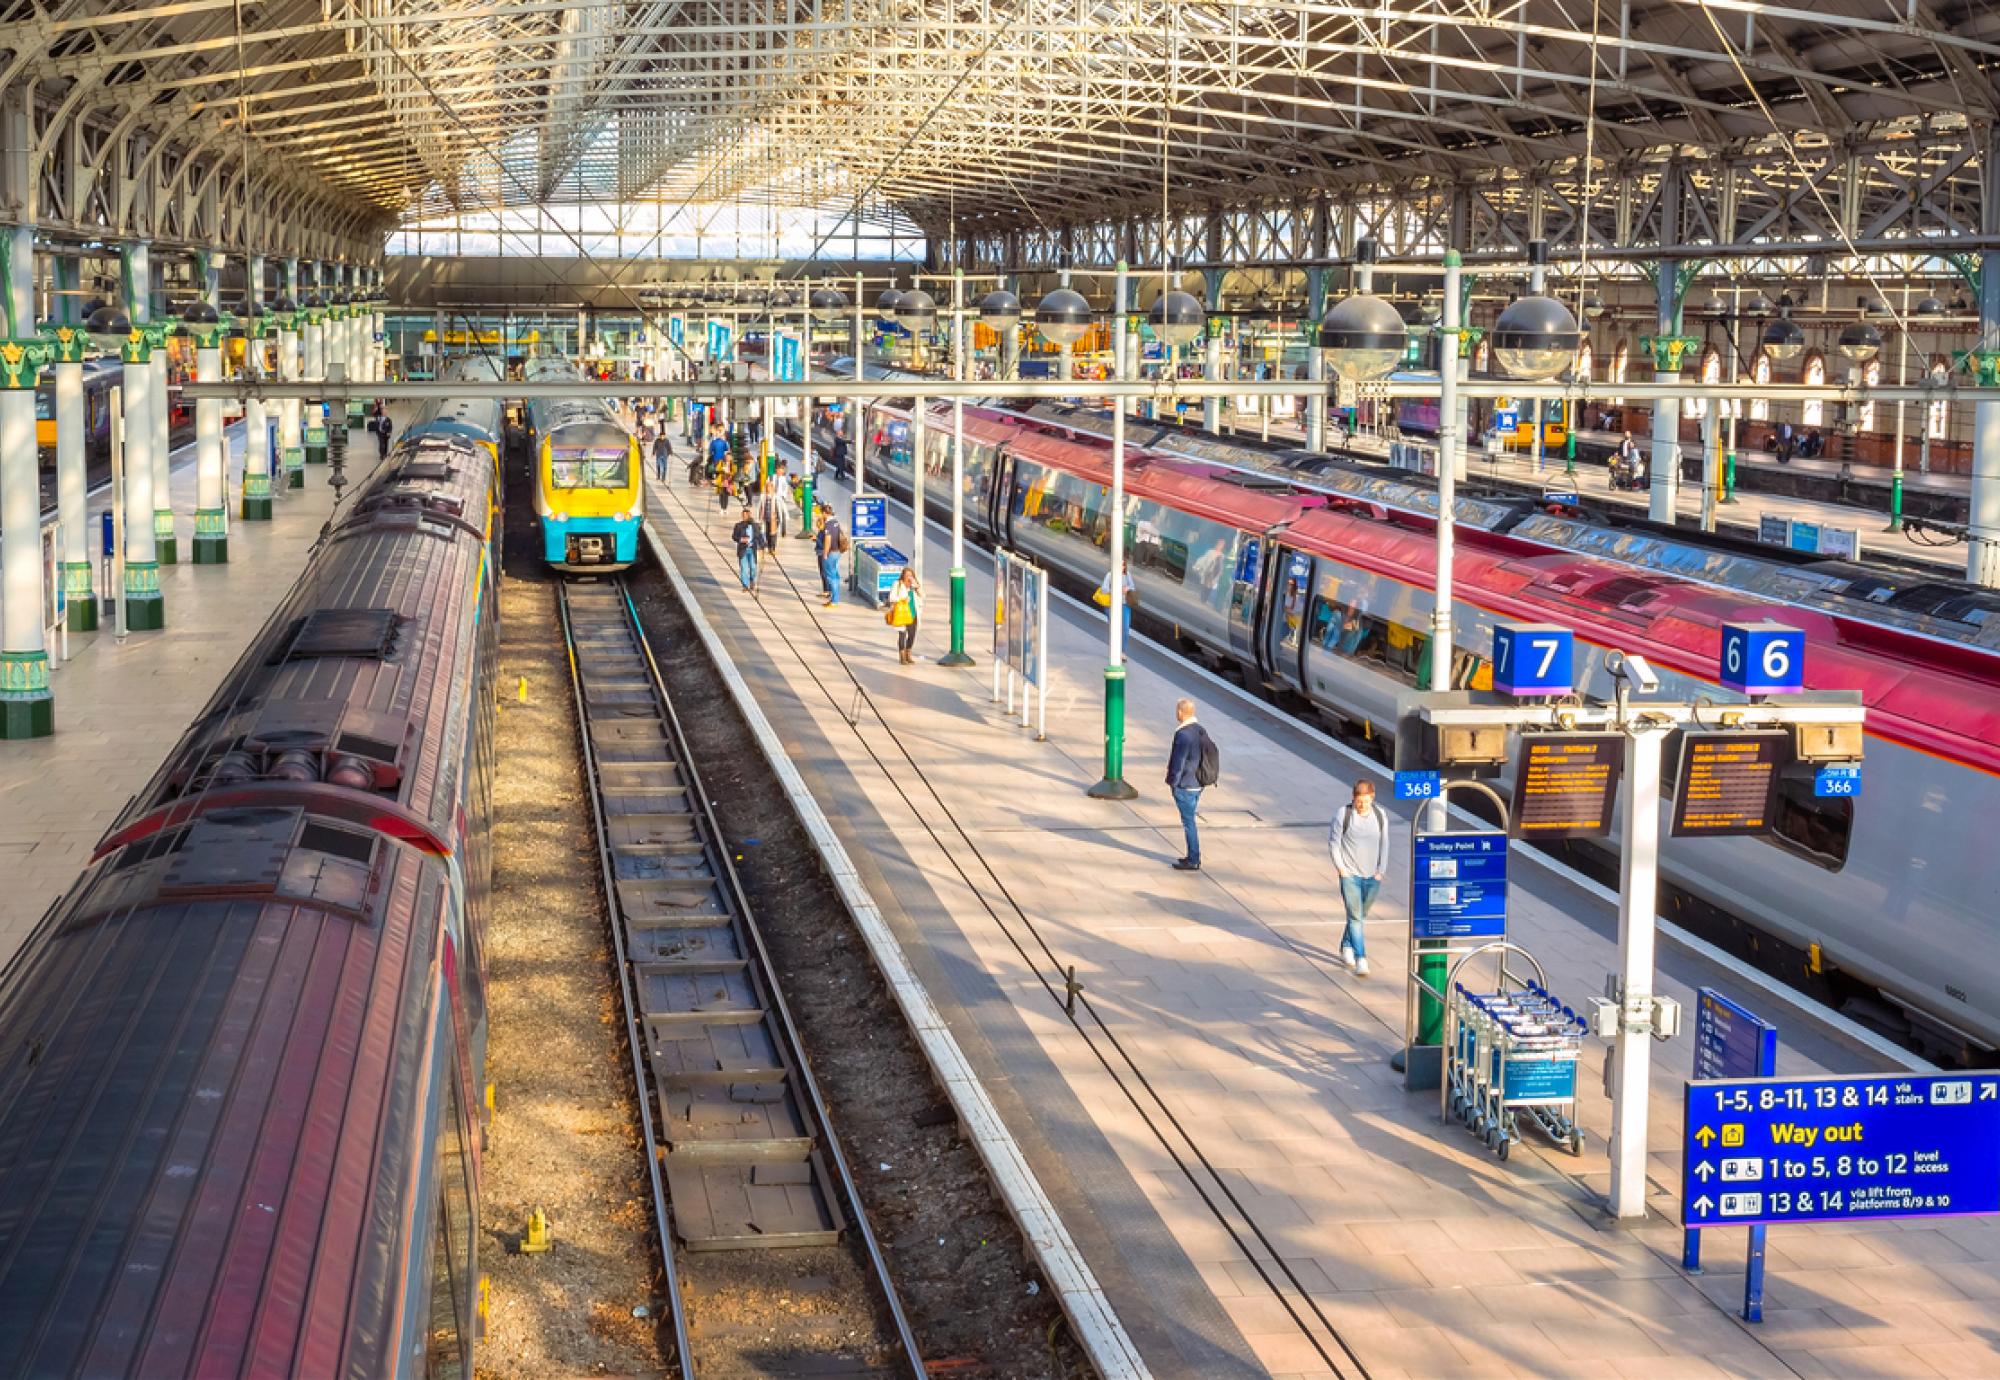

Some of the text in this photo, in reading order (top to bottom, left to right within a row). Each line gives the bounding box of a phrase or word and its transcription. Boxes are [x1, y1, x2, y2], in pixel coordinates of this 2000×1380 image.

[1498, 637, 1509, 674] 7
[1532, 639, 1560, 679] 7
[1727, 637, 1741, 673] 6
[1762, 639, 1791, 678] 6
[1405, 782, 1432, 797] 368
[1825, 779, 1852, 794] 366
[1455, 842, 1475, 850] Point
[1895, 1083, 1911, 1093] via
[1815, 1086, 1837, 1108] 13
[1841, 1086, 1860, 1107] &
[1865, 1085, 1889, 1106] 14
[1895, 1094, 1924, 1104] stairs
[1770, 1122, 1863, 1147] Way out
[1913, 1150, 1939, 1162] level
[1769, 1154, 1907, 1178] 1 to 5, 8 to 12
[1913, 1163, 1949, 1173] access
[1850, 1186, 1912, 1198] via lift from
[1768, 1190, 1843, 1213] 13 & 14
[1849, 1196, 1950, 1212] platforms 8/9 & 10
